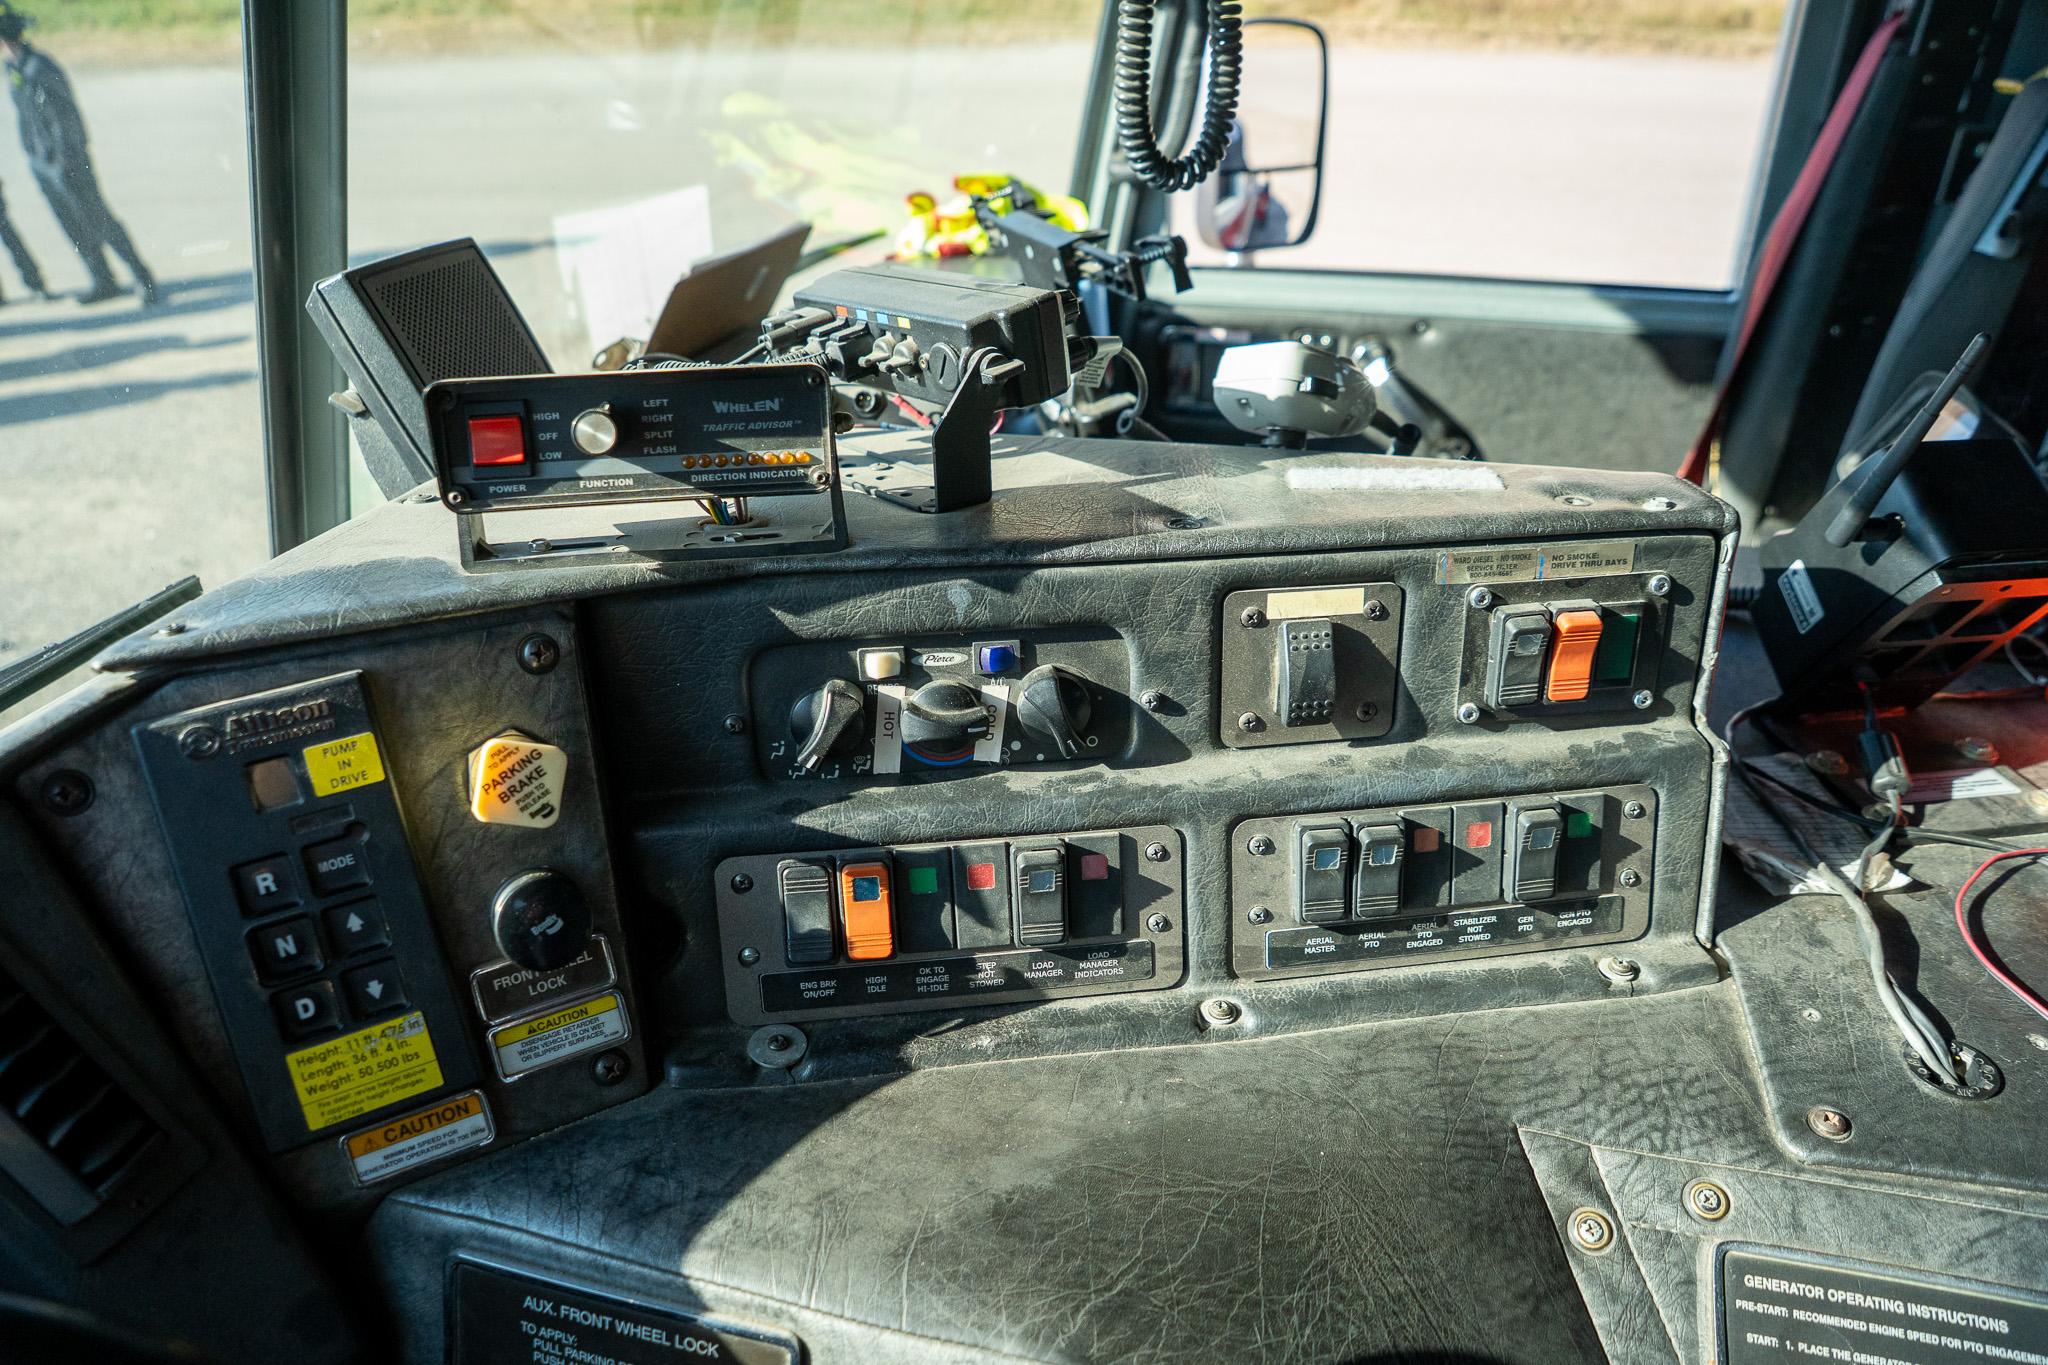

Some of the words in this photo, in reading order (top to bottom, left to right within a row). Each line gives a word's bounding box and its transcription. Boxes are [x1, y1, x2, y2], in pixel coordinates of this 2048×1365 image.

[644, 400, 668, 408] LEFT
[533, 412, 560, 422] HIGH
[641, 414, 674, 424] RIGHT
[702, 423, 744, 432] TRAFFIC
[538, 432, 559, 440] OFF
[644, 430, 674, 440] SPLIT
[643, 445, 677, 455] FLASH
[539, 451, 562, 461] LOW
[690, 472, 745, 483] DIRECTION
[749, 469, 805, 480] INDICATOR
[579, 478, 634, 489] FUNCTION
[489, 484, 526, 494] POWER
[1473, 555, 1494, 563] DIESEL
[1513, 553, 1532, 561] SMOKE
[1552, 554, 1565, 562] NO
[1466, 564, 1494, 572] SERVICE
[1551, 560, 1578, 569] DRIVE
[1579, 559, 1603, 568] THRU
[1605, 558, 1628, 566] BAYS
[924, 654, 954, 664] Pierce
[883, 712, 895, 740] HOT
[322, 741, 358, 758] PUMP
[338, 759, 352, 770] IN
[482, 749, 543, 795] PARKING
[330, 770, 368, 788] DRIVE
[498, 765, 547, 804] BRAKE
[536, 782, 546, 793] TO
[318, 854, 355, 873] MODE
[256, 872, 278, 896] R
[1454, 916, 1497, 926] STABILIZER
[1518, 916, 1534, 924] GEN
[1557, 918, 1592, 928] ENGAGED
[1412, 922, 1438, 930] AERIAL
[1518, 924, 1532, 932] PTO
[1358, 932, 1386, 940] AERIAL
[1458, 934, 1490, 942] STOWED
[275, 934, 298, 958] N
[1306, 937, 1334, 946] AERIAL
[1364, 940, 1380, 948] PTO
[1406, 938, 1443, 948] ENGAGED
[1304, 945, 1335, 954] MASTER
[1088, 952, 1110, 960] LOAD
[976, 962, 996, 970] STEP
[1032, 962, 1054, 970] LOAD
[1080, 960, 1118, 968] MANAGER
[933, 966, 944, 974] TO
[978, 970, 995, 978] NOT
[1024, 970, 1063, 978] MANAGER
[1074, 968, 1124, 978] INDICATORS
[865, 976, 886, 984] HIGH
[916, 974, 949, 984] ENGAGE
[970, 979, 1004, 988] STOWED
[528, 975, 567, 996] LOCK
[800, 981, 818, 990] ENG
[820, 980, 836, 988] BRK
[868, 984, 886, 993] IDLE
[918, 984, 948, 992] HI-IDLE
[804, 989, 834, 998] ON/OFF
[294, 998, 316, 1020] D
[537, 1007, 589, 1032] CAUTION
[521, 1029, 562, 1048] DISENGAGE
[562, 1017, 600, 1036] RETARDER
[518, 1043, 541, 1057] WHEN
[541, 1035, 570, 1050] VEHICLE
[570, 1033, 578, 1041] IS
[579, 1028, 590, 1037] ON
[591, 1022, 605, 1033] WET
[296, 1047, 343, 1066] Height:
[347, 1039, 361, 1050] 11
[522, 1054, 533, 1063] OR
[534, 1043, 568, 1059] SLIPPERY
[300, 1060, 349, 1082] Length:
[352, 1053, 368, 1064] 36
[385, 1044, 393, 1052] 4
[305, 1074, 356, 1096] Weight:
[402, 1052, 420, 1064] lbs
[384, 1102, 471, 1143] CAUTION
[384, 1146, 417, 1160] MINIMUM
[417, 1137, 442, 1148] SPEED
[442, 1130, 459, 1139] FOR
[359, 1158, 405, 1177] GENERATOR
[405, 1144, 448, 1160] OPERATION
[1744, 1274, 1824, 1300] GENERATOR
[1827, 1288, 1904, 1314] OPERATING
[1907, 1303, 2009, 1334] INSTRUCTIONS
[522, 1296, 557, 1316] AUX.
[560, 1306, 612, 1330] FRONT
[616, 1320, 671, 1346] WHEEL
[674, 1332, 719, 1358] LOCK
[1736, 1299, 1789, 1318] PRE-START:
[1793, 1310, 1866, 1332] RECOMMENDED
[1870, 1323, 1904, 1338] ENGINE
[1907, 1330, 1940, 1346] SPEED
[1941, 1336, 1962, 1350] FOR
[1964, 1340, 1984, 1354] PTO
[520, 1320, 536, 1334] TO
[538, 1326, 578, 1346] APPLY:
[533, 1338, 562, 1356] PULL
[565, 1347, 616, 1365] PARKING
[1746, 1333, 1780, 1348] START:
[1786, 1340, 1794, 1350] 1.
[1798, 1342, 1830, 1358] PLACE
[1831, 1348, 1850, 1362] THE
